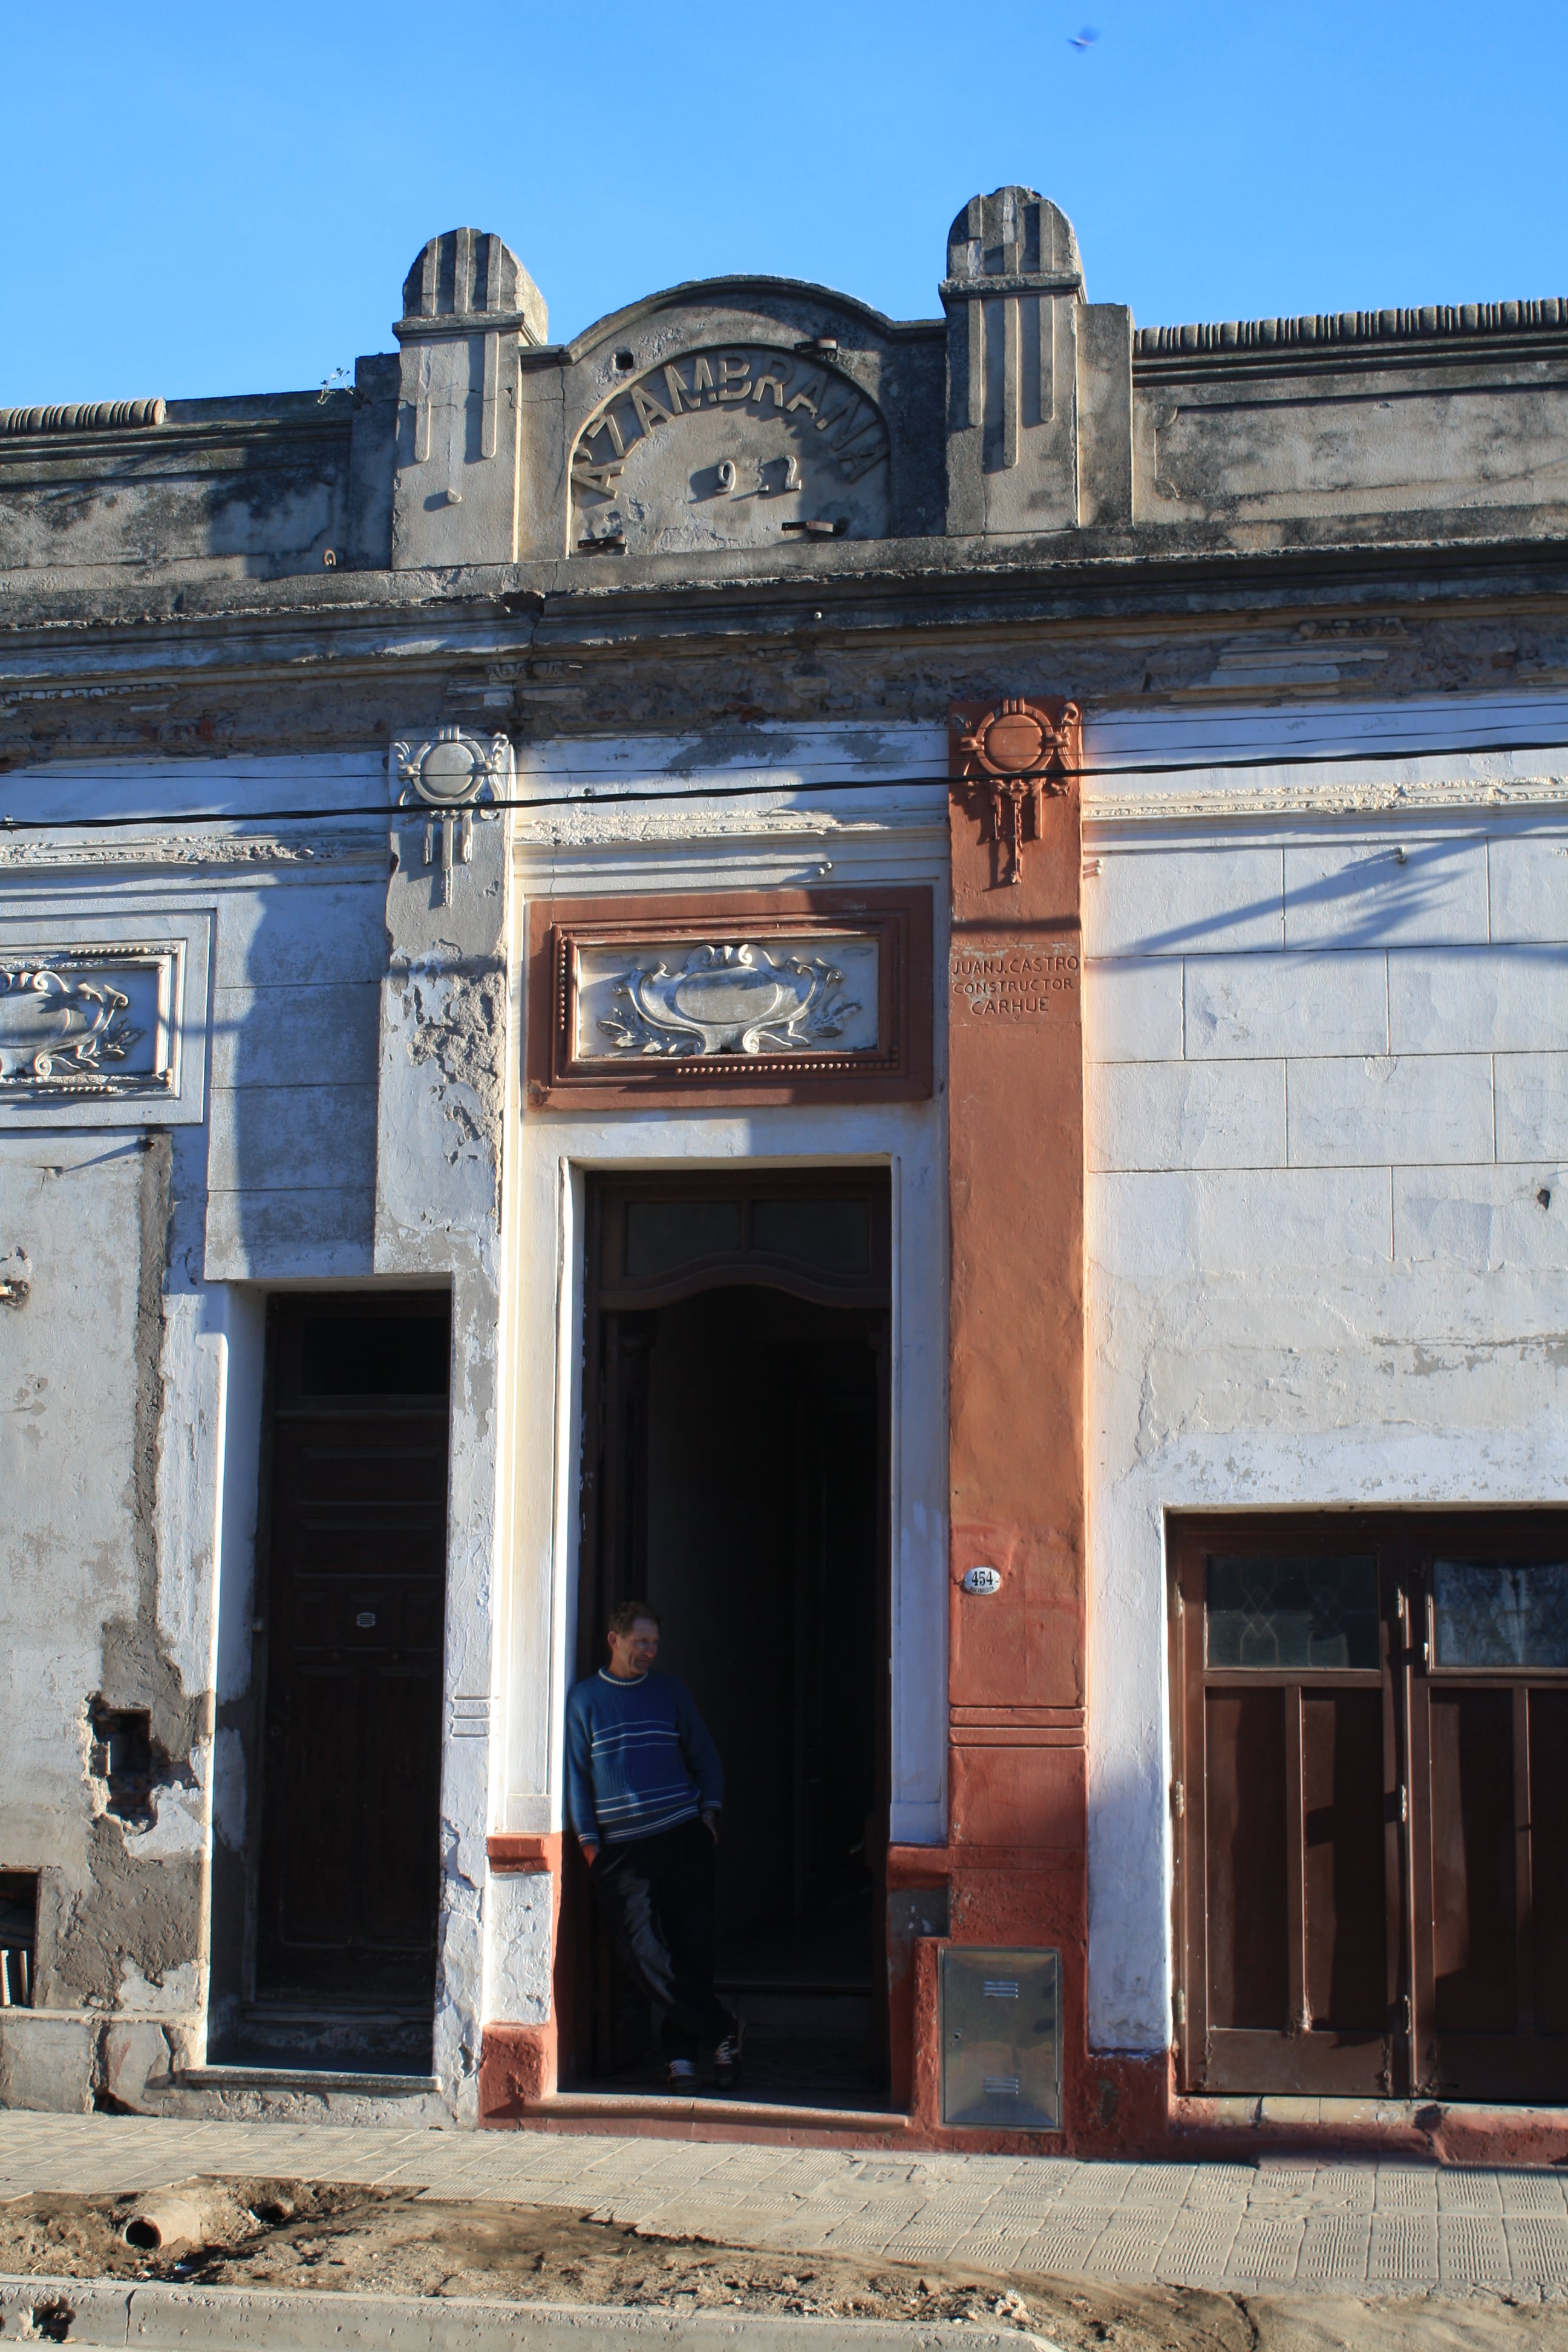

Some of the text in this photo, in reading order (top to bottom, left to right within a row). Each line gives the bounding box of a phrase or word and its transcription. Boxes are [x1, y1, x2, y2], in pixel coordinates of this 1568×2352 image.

[952, 960, 993, 976] JUAN
[1009, 956, 1079, 973] CASTRO
[953, 978, 1073, 995] CONSTRUCTOR
[971, 996, 1049, 1016] CARHUE
[972, 1570, 993, 1586] 454
